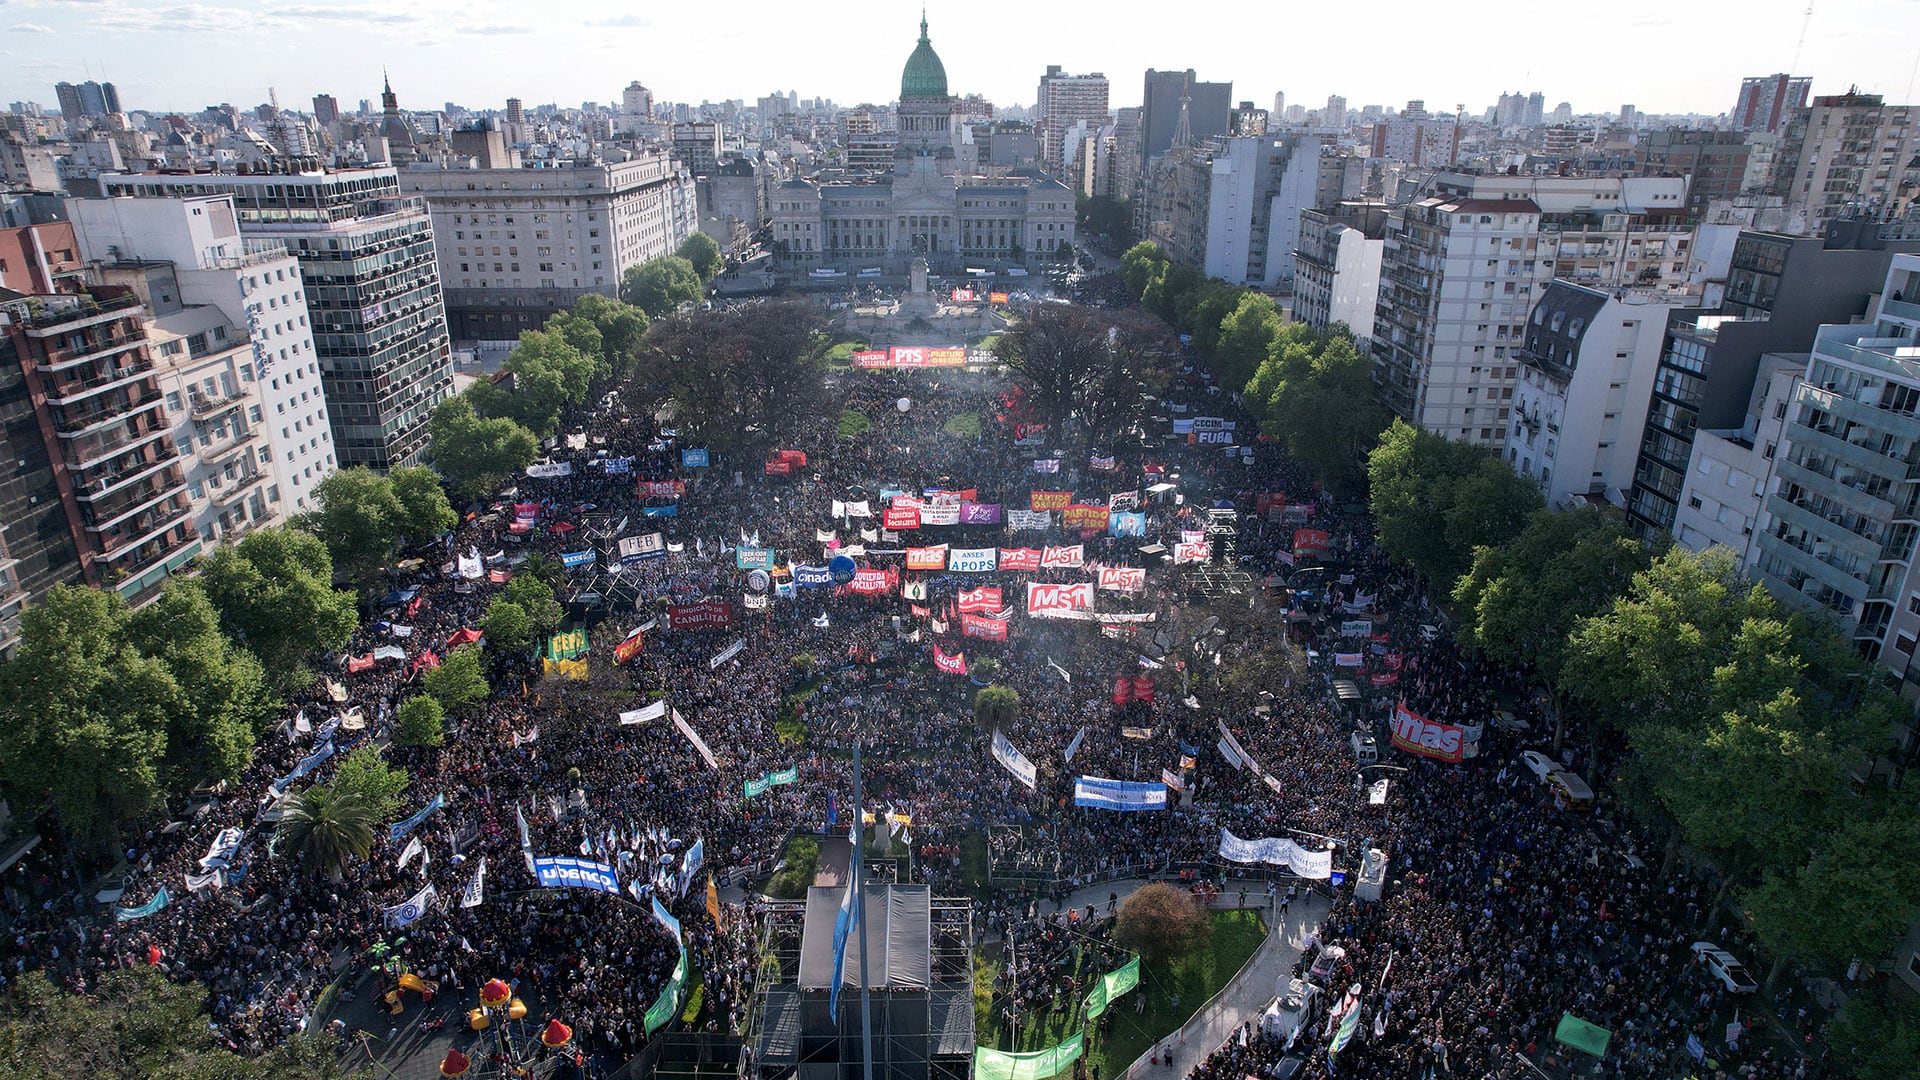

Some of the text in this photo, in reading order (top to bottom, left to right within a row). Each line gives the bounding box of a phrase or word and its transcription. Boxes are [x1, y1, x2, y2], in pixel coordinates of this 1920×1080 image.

[896, 349, 922, 362] PTS
[1199, 432, 1233, 443] FUBA
[1063, 508, 1109, 519] PARTIDO
[627, 536, 654, 549] FEB
[909, 548, 944, 563] mas
[1001, 550, 1026, 561] PTS
[1049, 548, 1081, 562] MST
[951, 560, 995, 571] APOPS
[1104, 571, 1141, 586] MST
[959, 589, 984, 604] PTS
[1034, 586, 1087, 610] MST
[678, 605, 711, 615] SINDICATO
[674, 613, 729, 625] CANILLITAS
[965, 616, 1000, 630] Juventud
[968, 626, 985, 637] PTS
[1394, 710, 1461, 753] mas
